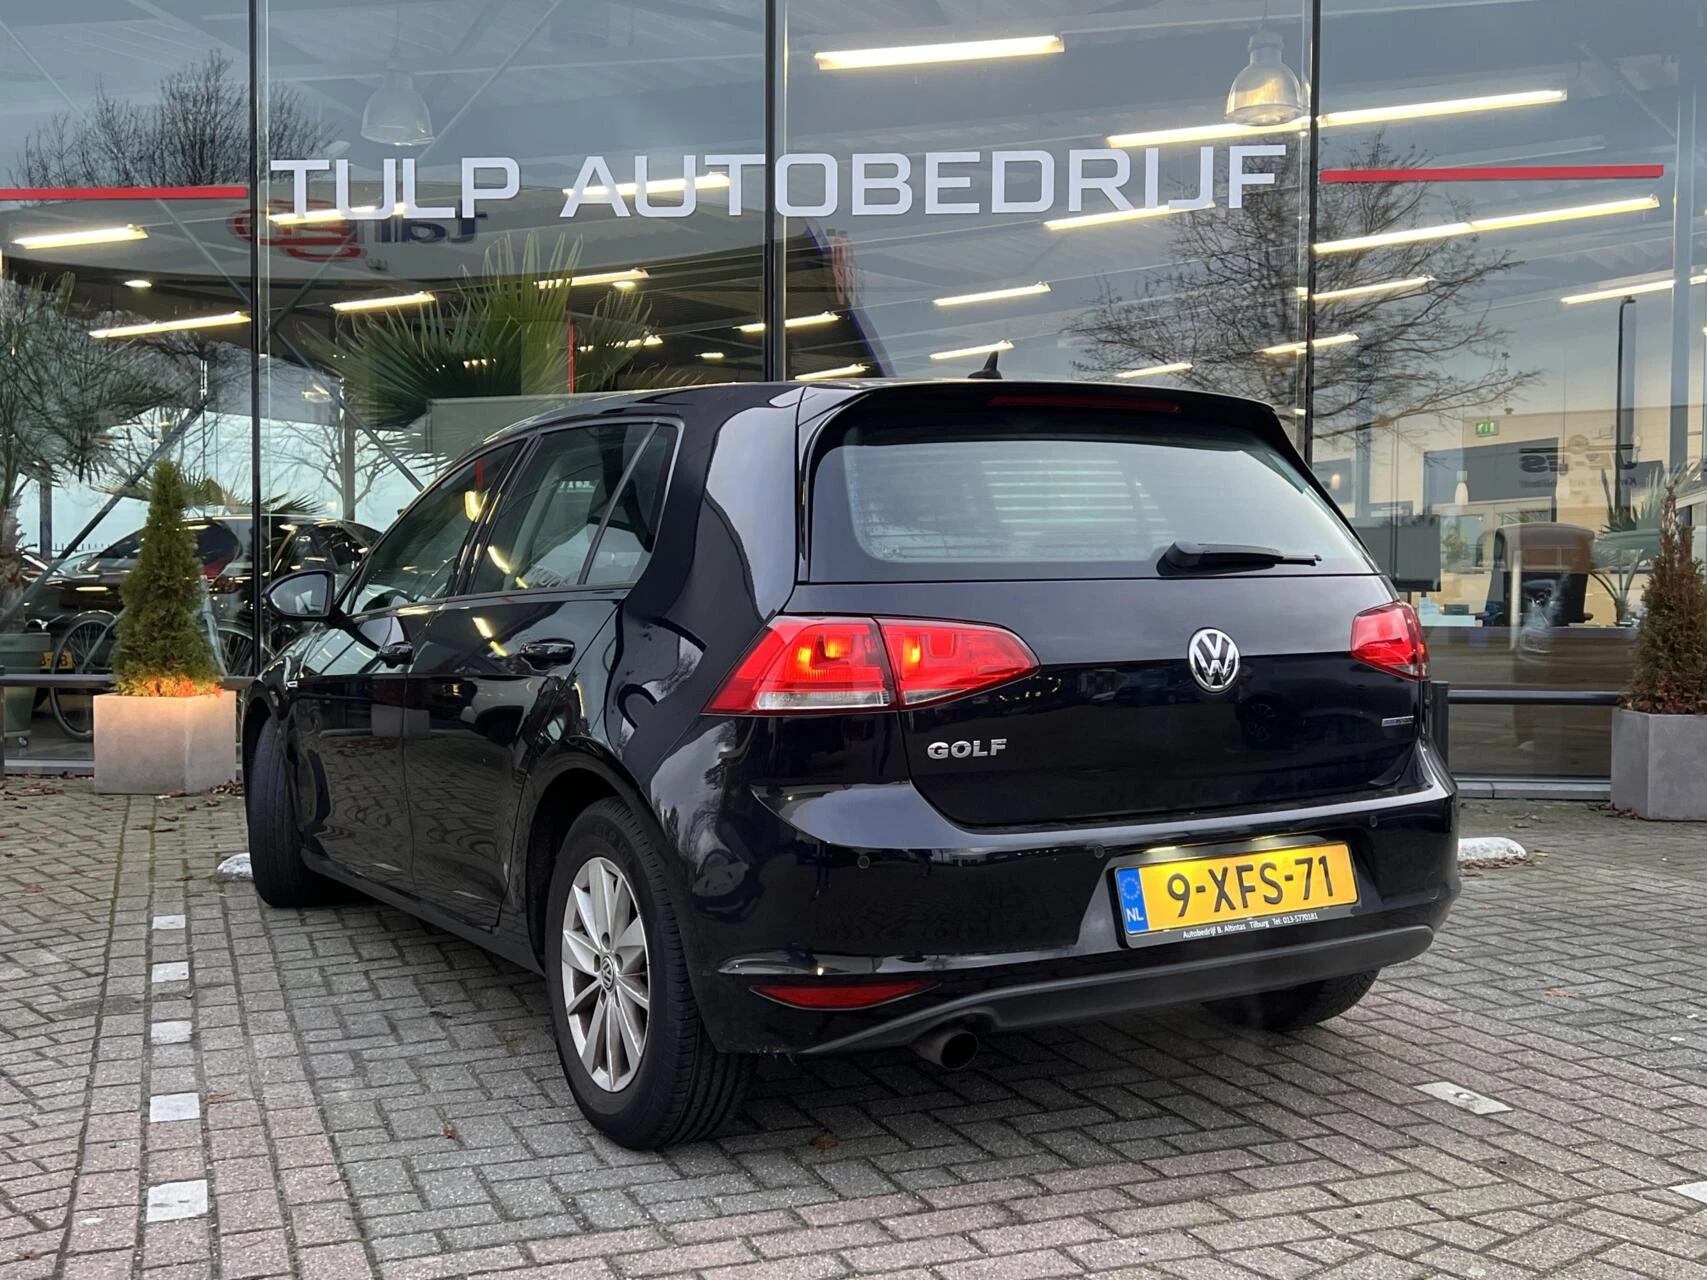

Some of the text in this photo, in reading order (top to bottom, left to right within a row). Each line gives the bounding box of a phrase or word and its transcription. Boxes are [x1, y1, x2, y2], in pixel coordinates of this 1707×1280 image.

[270, 144, 1287, 221] TULP AUTOBEDRIJF
[927, 738, 1007, 760] GOLF
[1167, 855, 1334, 918] 9-XFS-71
[1126, 907, 1145, 922] NL
[1183, 926, 1216, 939] Autobedrijf
[1249, 920, 1270, 929] Tilburg
